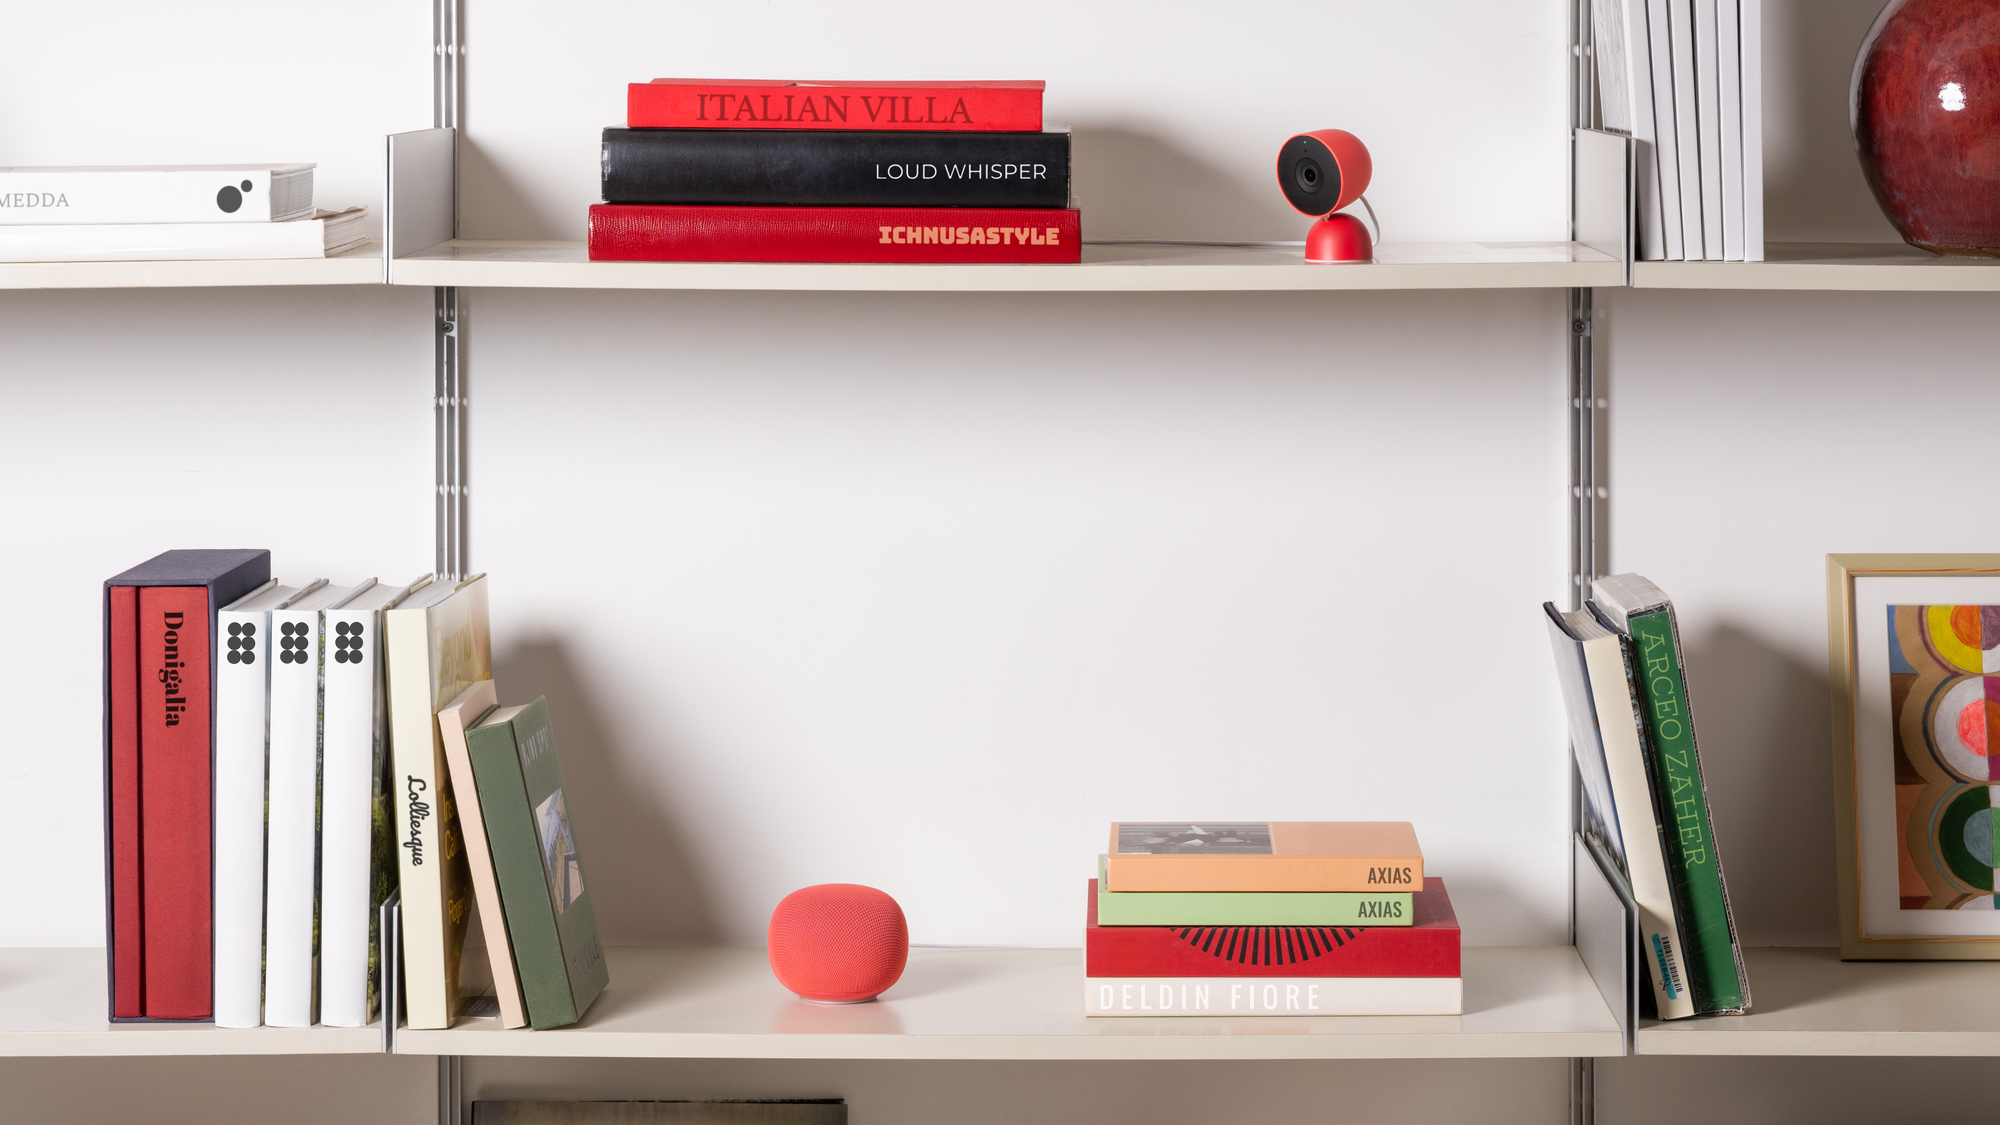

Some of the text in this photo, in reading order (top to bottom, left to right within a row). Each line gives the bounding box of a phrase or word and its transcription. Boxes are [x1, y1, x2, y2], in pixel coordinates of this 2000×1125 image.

[696, 93, 974, 124] ITALIAN VILLA
[876, 163, 1047, 180] LOUD WHISPER
[878, 226, 1060, 246] ICHNUSASTYLE
[158, 610, 187, 728] Donigalia
[1641, 630, 1706, 869] ARCEO ZAHER
[402, 774, 430, 867] Lolliesque
[1367, 867, 1412, 885] AXIAS
[1357, 900, 1403, 919] AXIAS
[1099, 984, 1320, 1010] DELDIN FIORE
